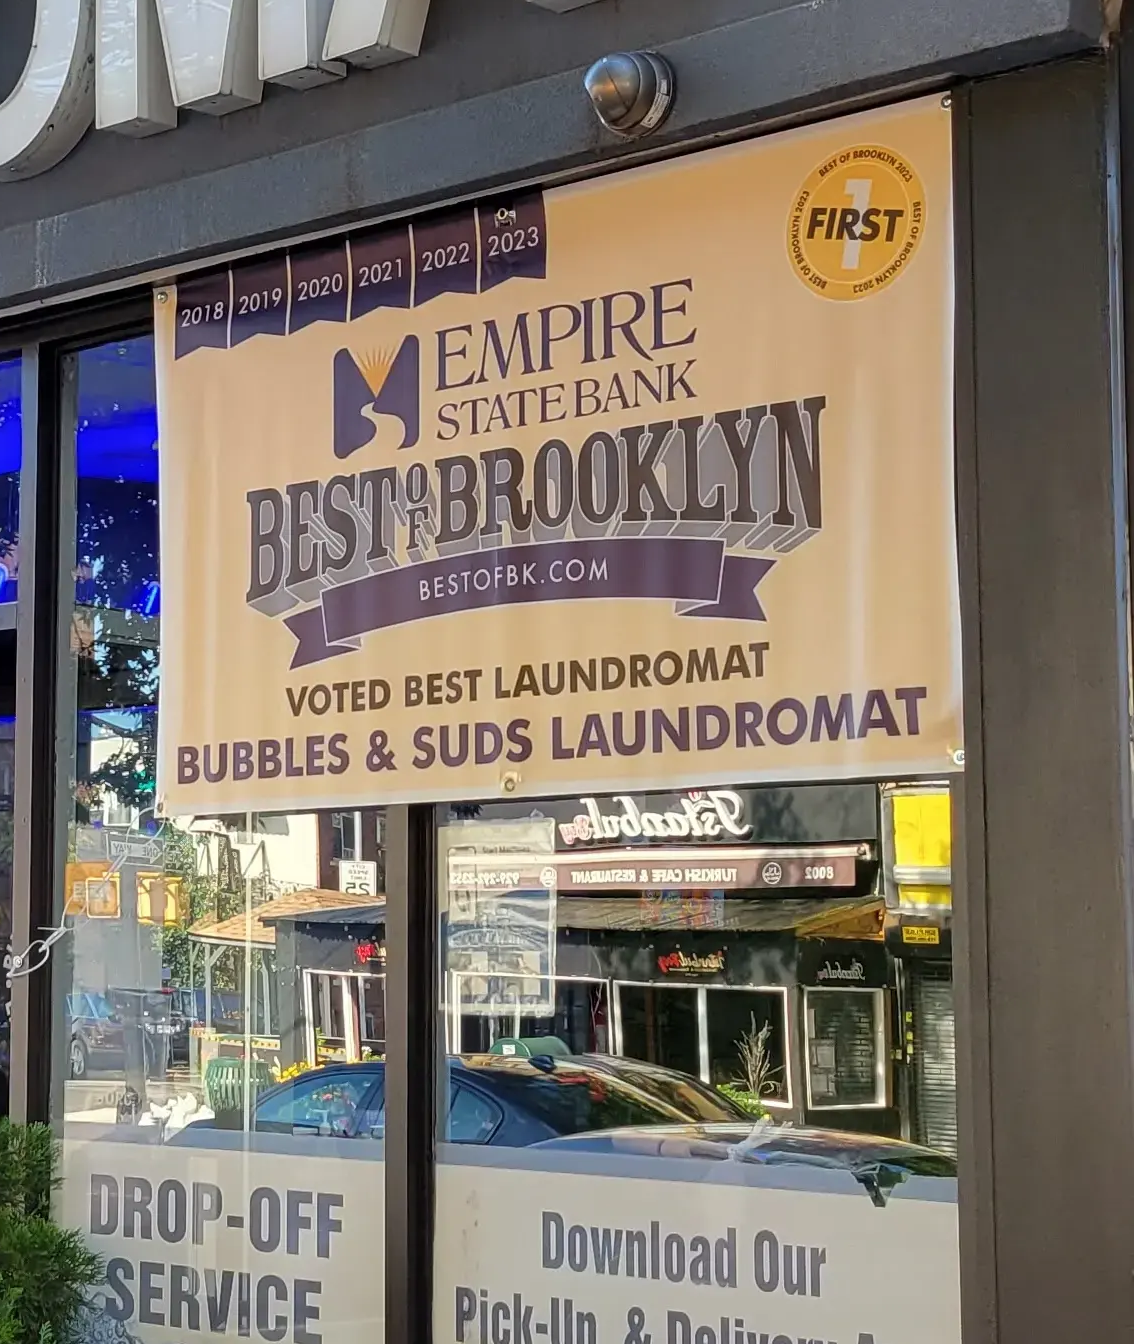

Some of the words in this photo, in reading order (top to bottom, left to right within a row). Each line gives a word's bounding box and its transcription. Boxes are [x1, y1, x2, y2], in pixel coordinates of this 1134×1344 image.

[487, 226, 540, 257] 2023
[806, 207, 905, 243] FIRST
[358, 258, 403, 287] 2021
[421, 242, 470, 273] 2022
[238, 287, 283, 315] 2019
[297, 273, 343, 302] 2020
[181, 301, 224, 328] 2018
[434, 278, 698, 392] EMPIRE
[436, 383, 567, 441] STATE
[574, 359, 698, 418] BANK
[245, 465, 396, 603] BEST
[406, 461, 430, 551] OF
[433, 396, 826, 546] BROOKLYN
[419, 557, 610, 602] BESTOFBK.COM
[286, 678, 391, 718] VOTED
[404, 668, 482, 708] BEST
[495, 642, 770, 699] LAUNDROMAT
[177, 733, 350, 785] BUBBLES
[366, 730, 396, 771] &
[412, 718, 533, 770] SUDS
[553, 686, 927, 760] LAUNDROMAT
[90, 1173, 344, 1258] DROP-OFF
[541, 1211, 737, 1288] Download
[754, 1229, 827, 1297] Our
